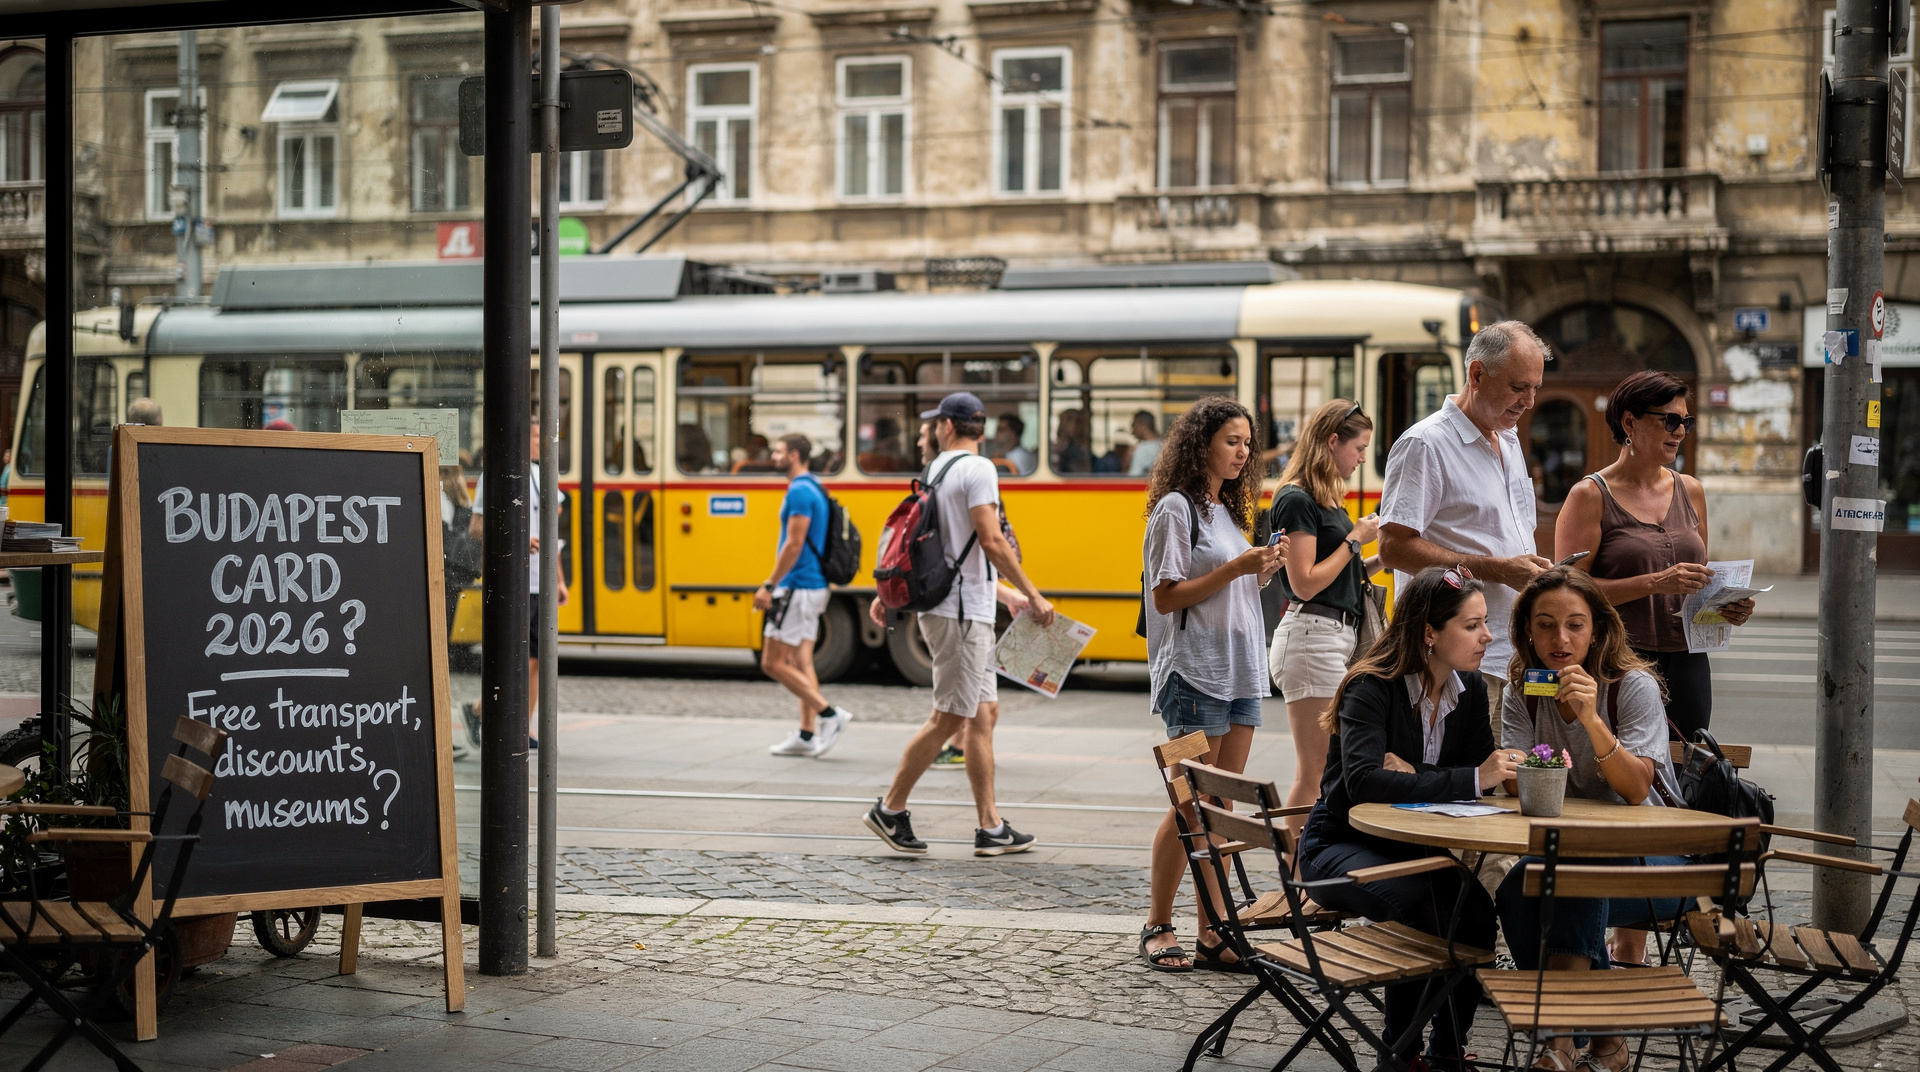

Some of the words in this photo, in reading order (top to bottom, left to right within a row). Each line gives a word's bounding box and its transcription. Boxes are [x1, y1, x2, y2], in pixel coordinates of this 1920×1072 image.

[158, 486, 402, 544] BUDAPEST
[210, 551, 342, 604] CARD
[187, 689, 261, 731] Free
[268, 685, 422, 739] transport,
[214, 735, 376, 778] discounts,
